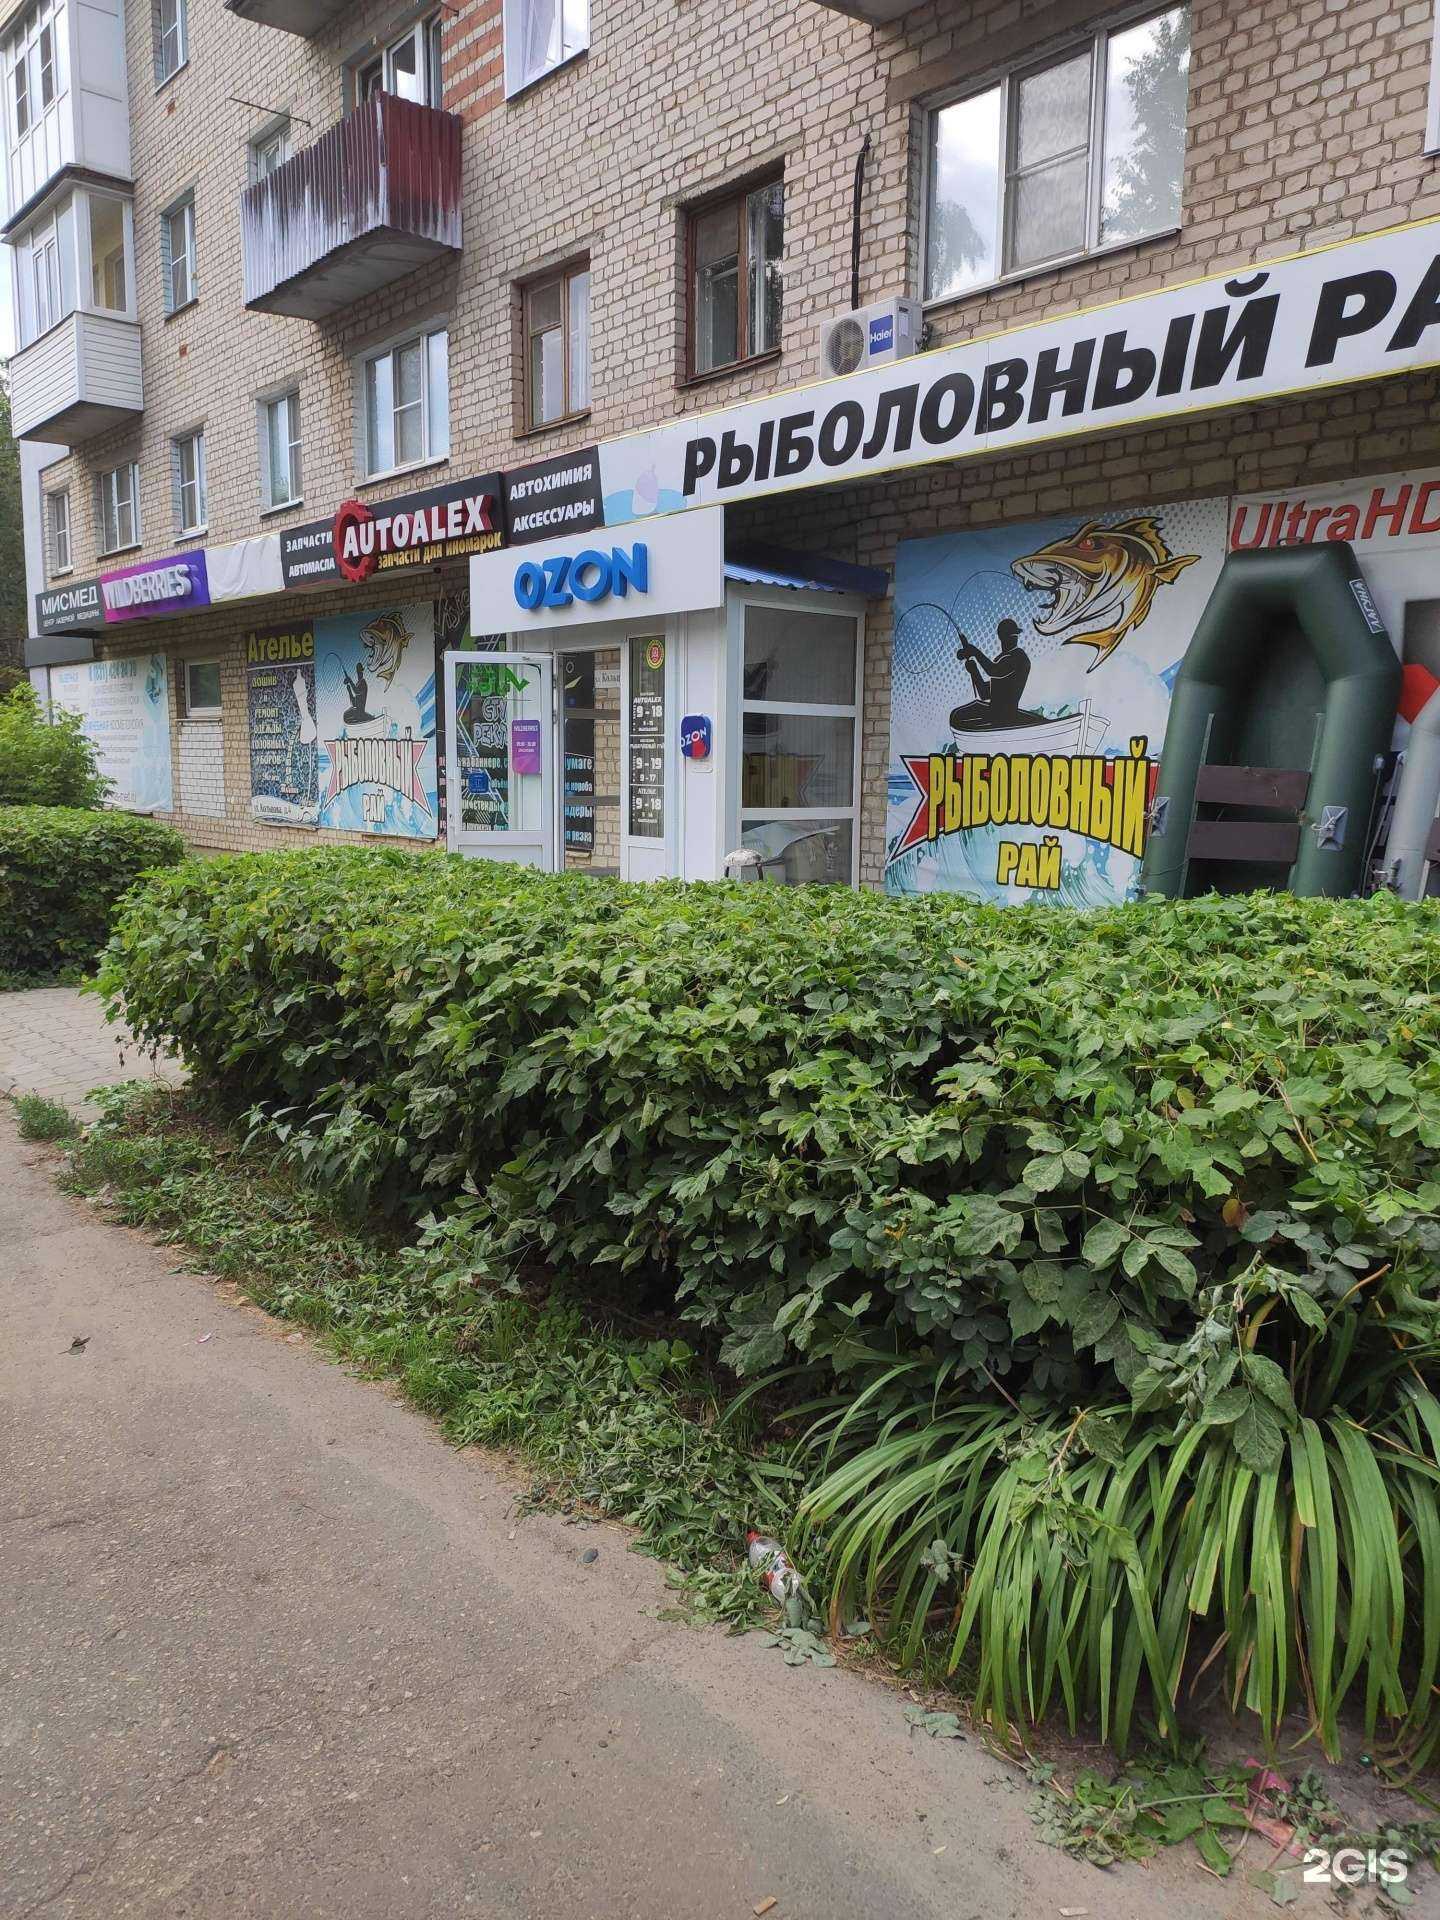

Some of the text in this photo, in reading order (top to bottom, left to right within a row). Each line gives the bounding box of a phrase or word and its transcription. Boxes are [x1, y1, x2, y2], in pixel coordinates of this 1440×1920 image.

[870, 328, 893, 343] Haier
[682, 272, 1281, 497] РЫБОЛОВНЫЙ
[510, 463, 592, 501] АВТОХИМИЯ
[342, 494, 493, 559] AUTOALEX
[513, 498, 595, 533] АКСЕССУАРЫ
[286, 530, 333, 553] ЗАПЧАСТИ
[377, 531, 503, 569] запчасти для иномарок
[288, 557, 335, 578] АВТОМАСЛА
[513, 542, 649, 610] OZON
[42, 585, 98, 615] МИСМЕД
[102, 564, 192, 609] WILDBERRIES
[248, 632, 314, 662] Ателье
[680, 726, 707, 748] OZON
[565, 757, 593, 770] умаге
[928, 736, 1149, 859] РЫБОЛОВНЫЙ
[996, 836, 1062, 890] РАЙ
